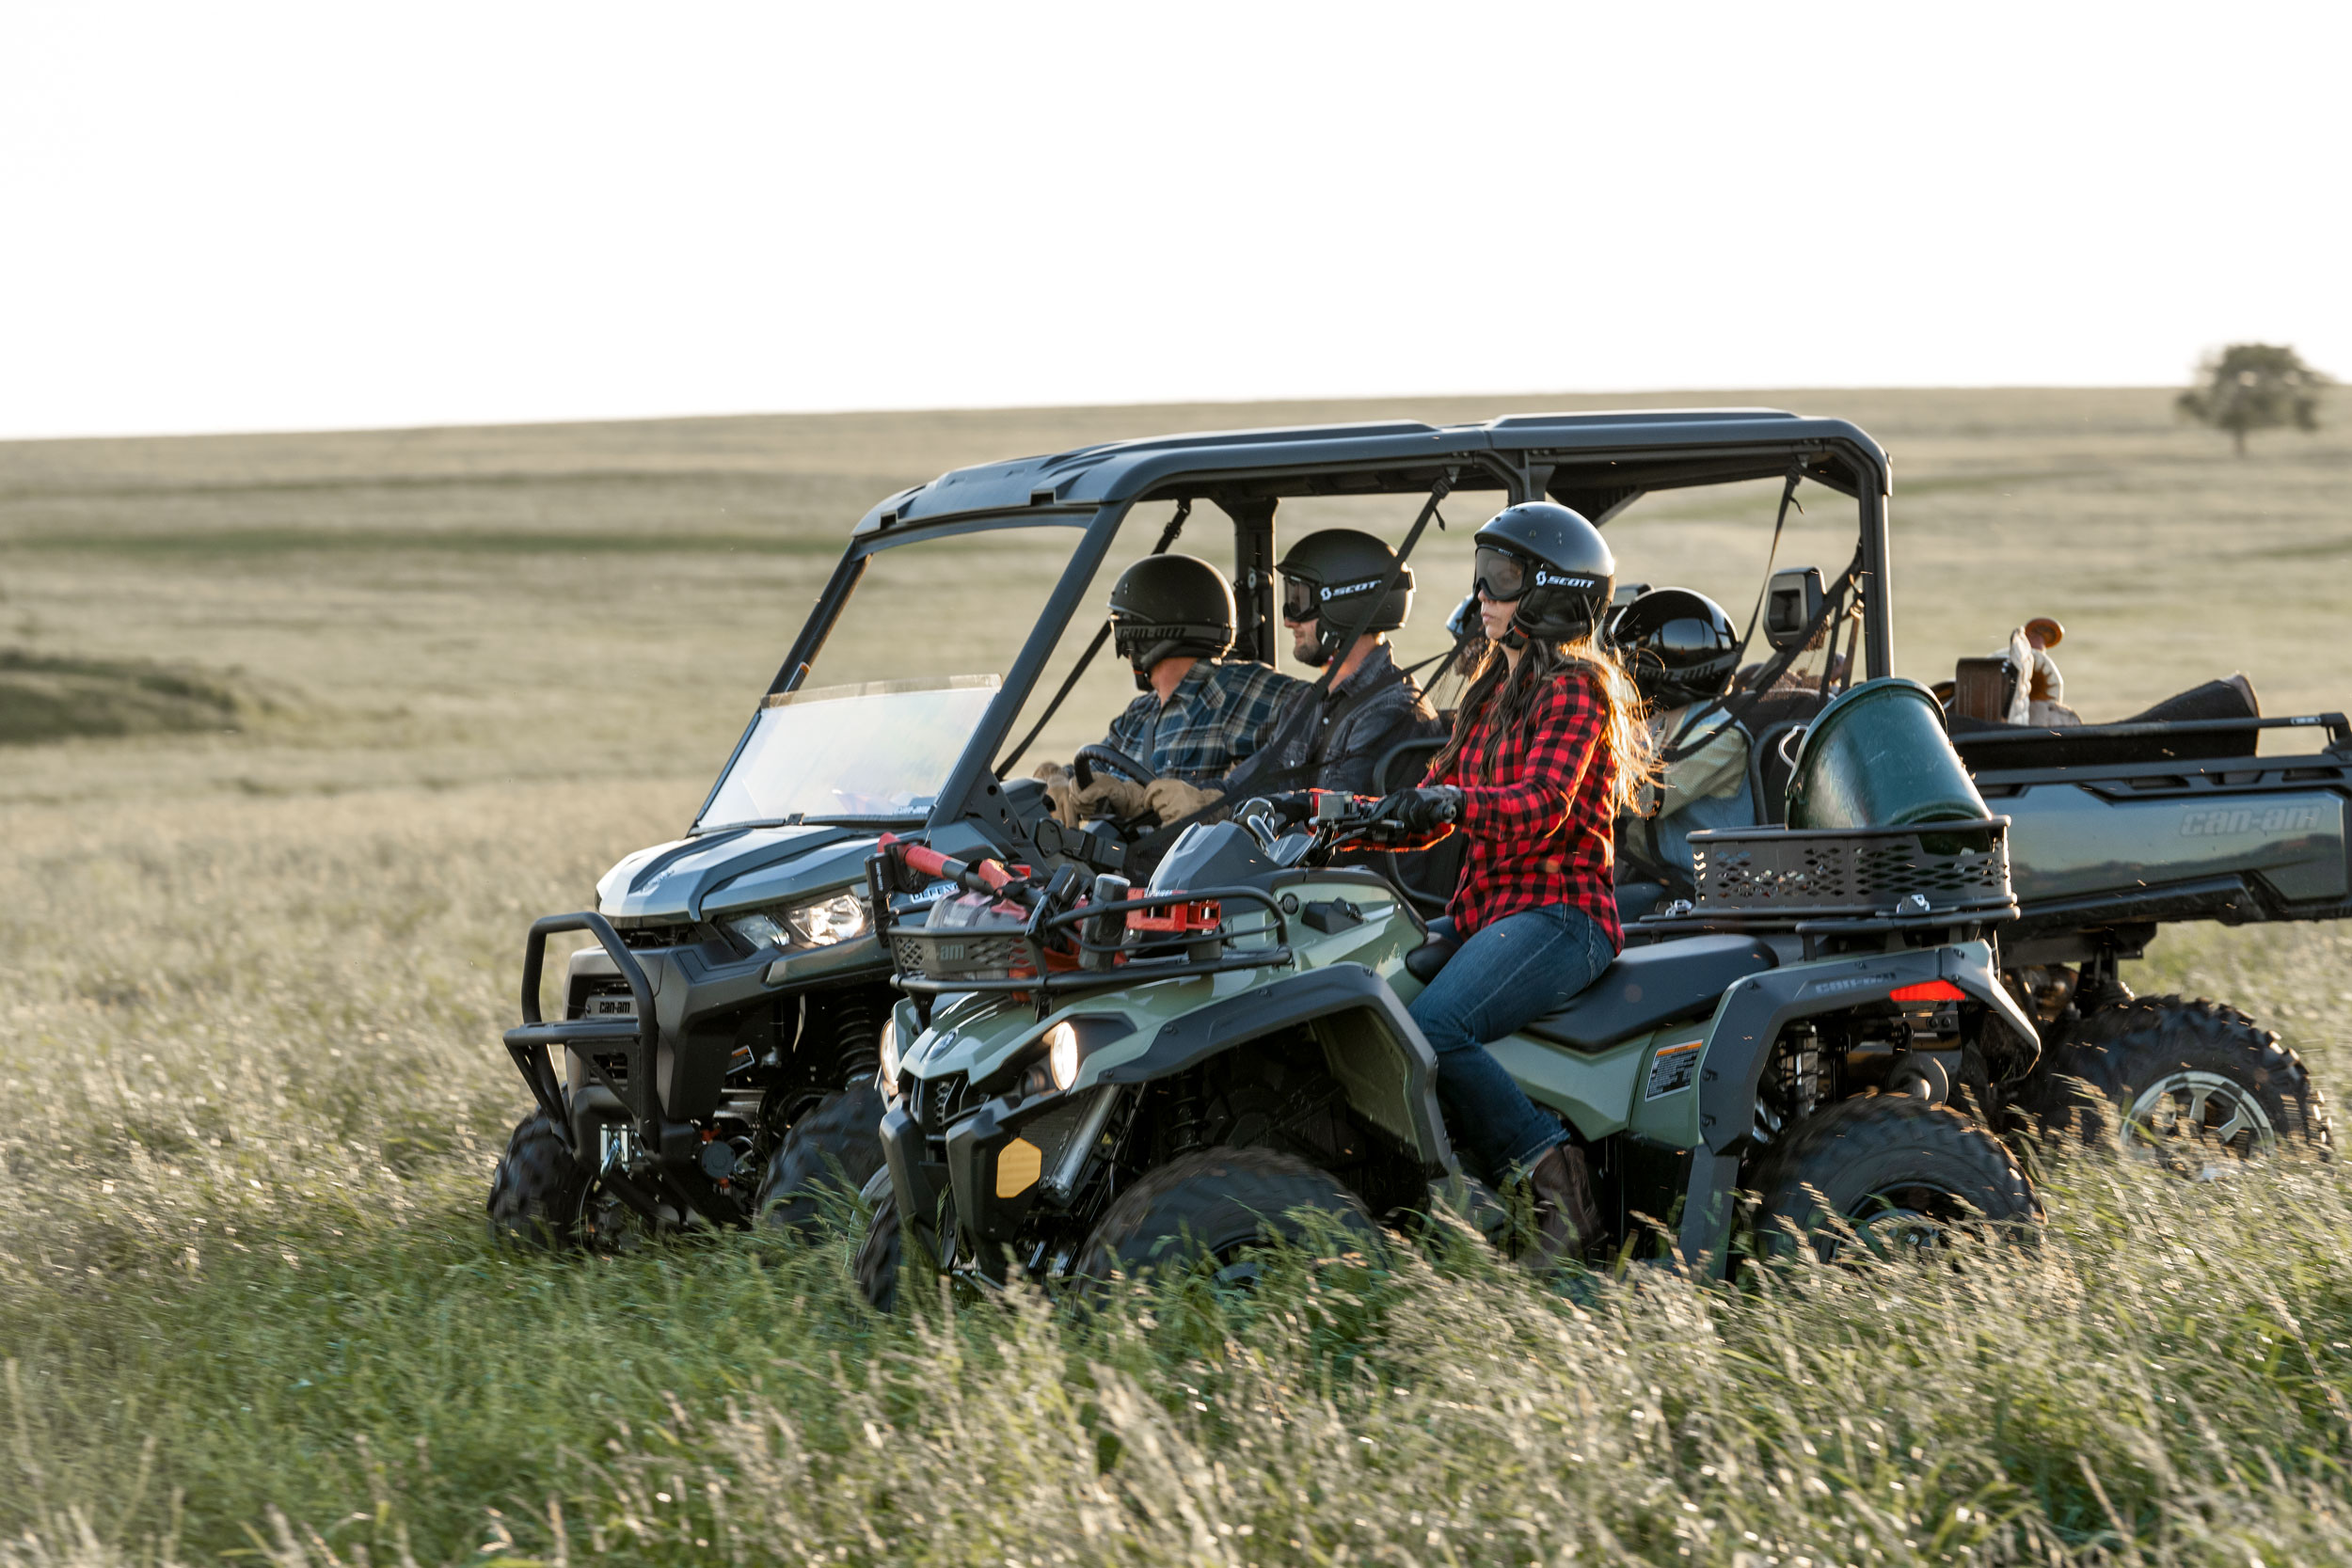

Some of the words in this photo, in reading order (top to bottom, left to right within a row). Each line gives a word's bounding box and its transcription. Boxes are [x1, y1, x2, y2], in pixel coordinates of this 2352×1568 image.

[1333, 579, 1382, 596] SCOT
[1548, 576, 1595, 588] SCOTT
[2181, 805, 2324, 836] can-am
[599, 1001, 630, 1013] can-am
